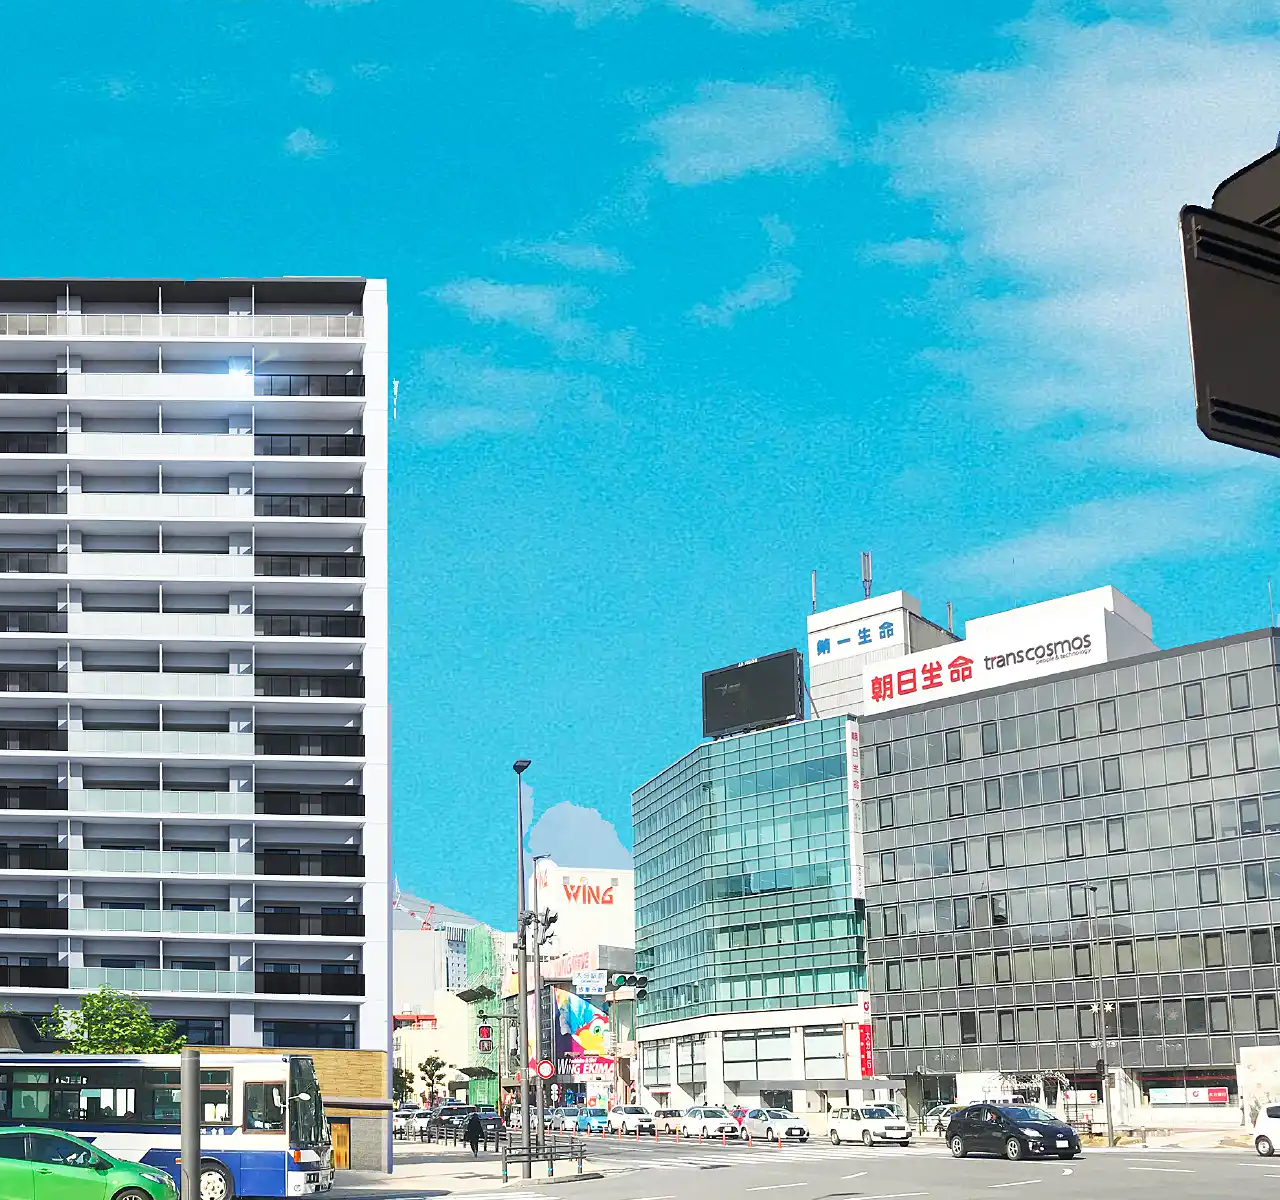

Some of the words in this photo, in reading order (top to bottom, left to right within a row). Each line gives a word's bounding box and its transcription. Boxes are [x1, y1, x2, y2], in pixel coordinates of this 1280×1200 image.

[817, 621, 894, 656] 第一生命
[984, 634, 1092, 670] transcosmos
[871, 655, 974, 702] 朝日生命
[563, 883, 614, 905] WING
